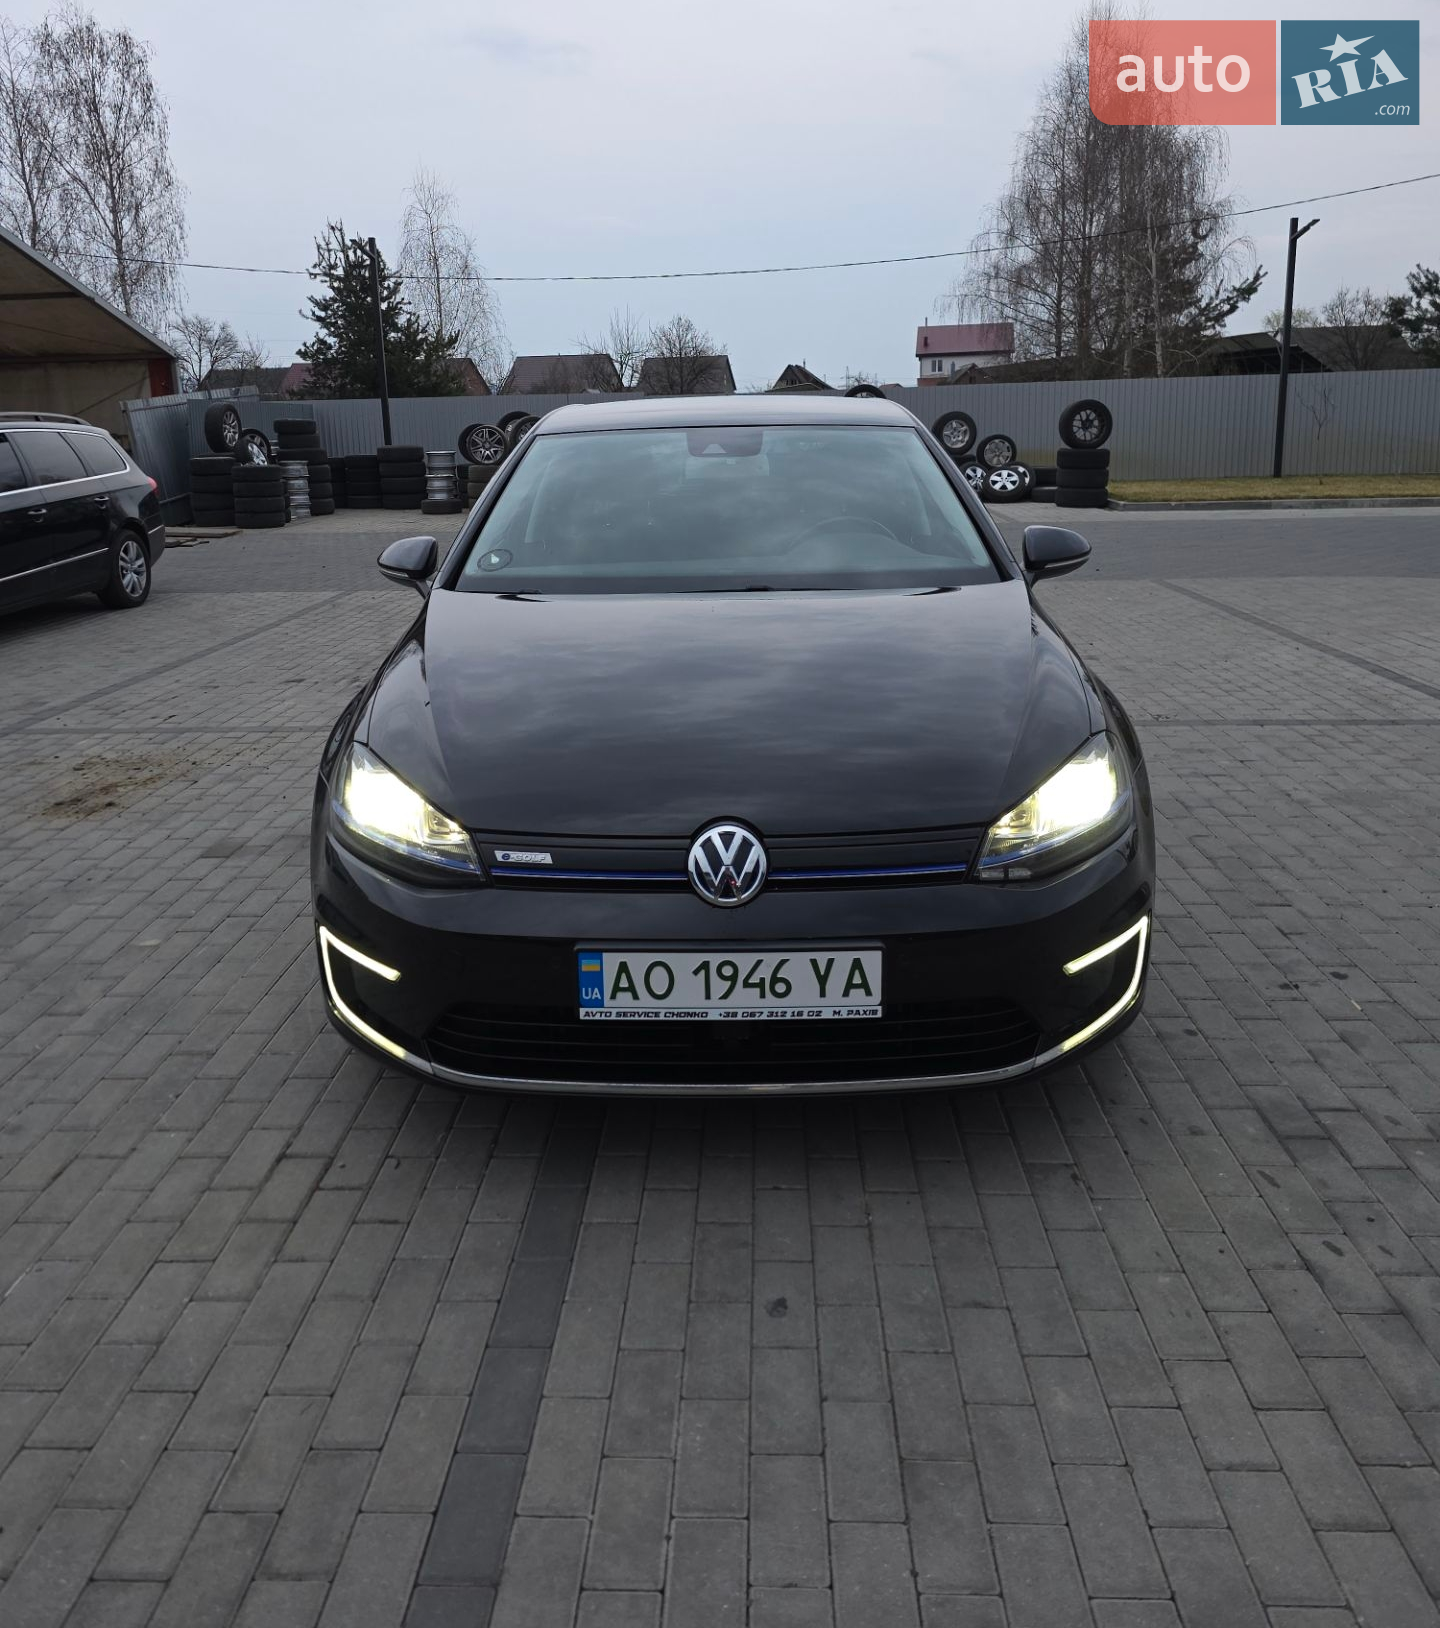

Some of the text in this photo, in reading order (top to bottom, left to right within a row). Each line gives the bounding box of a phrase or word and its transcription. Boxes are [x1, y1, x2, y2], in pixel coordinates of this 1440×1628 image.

[609, 957, 874, 1001] AO 1946 YA
[582, 987, 602, 1000] UA
[583, 1010, 612, 1019] AVTO
[614, 1011, 661, 1019] SERVICE
[766, 1010, 788, 1018] 312
[806, 1010, 823, 1018] 02
